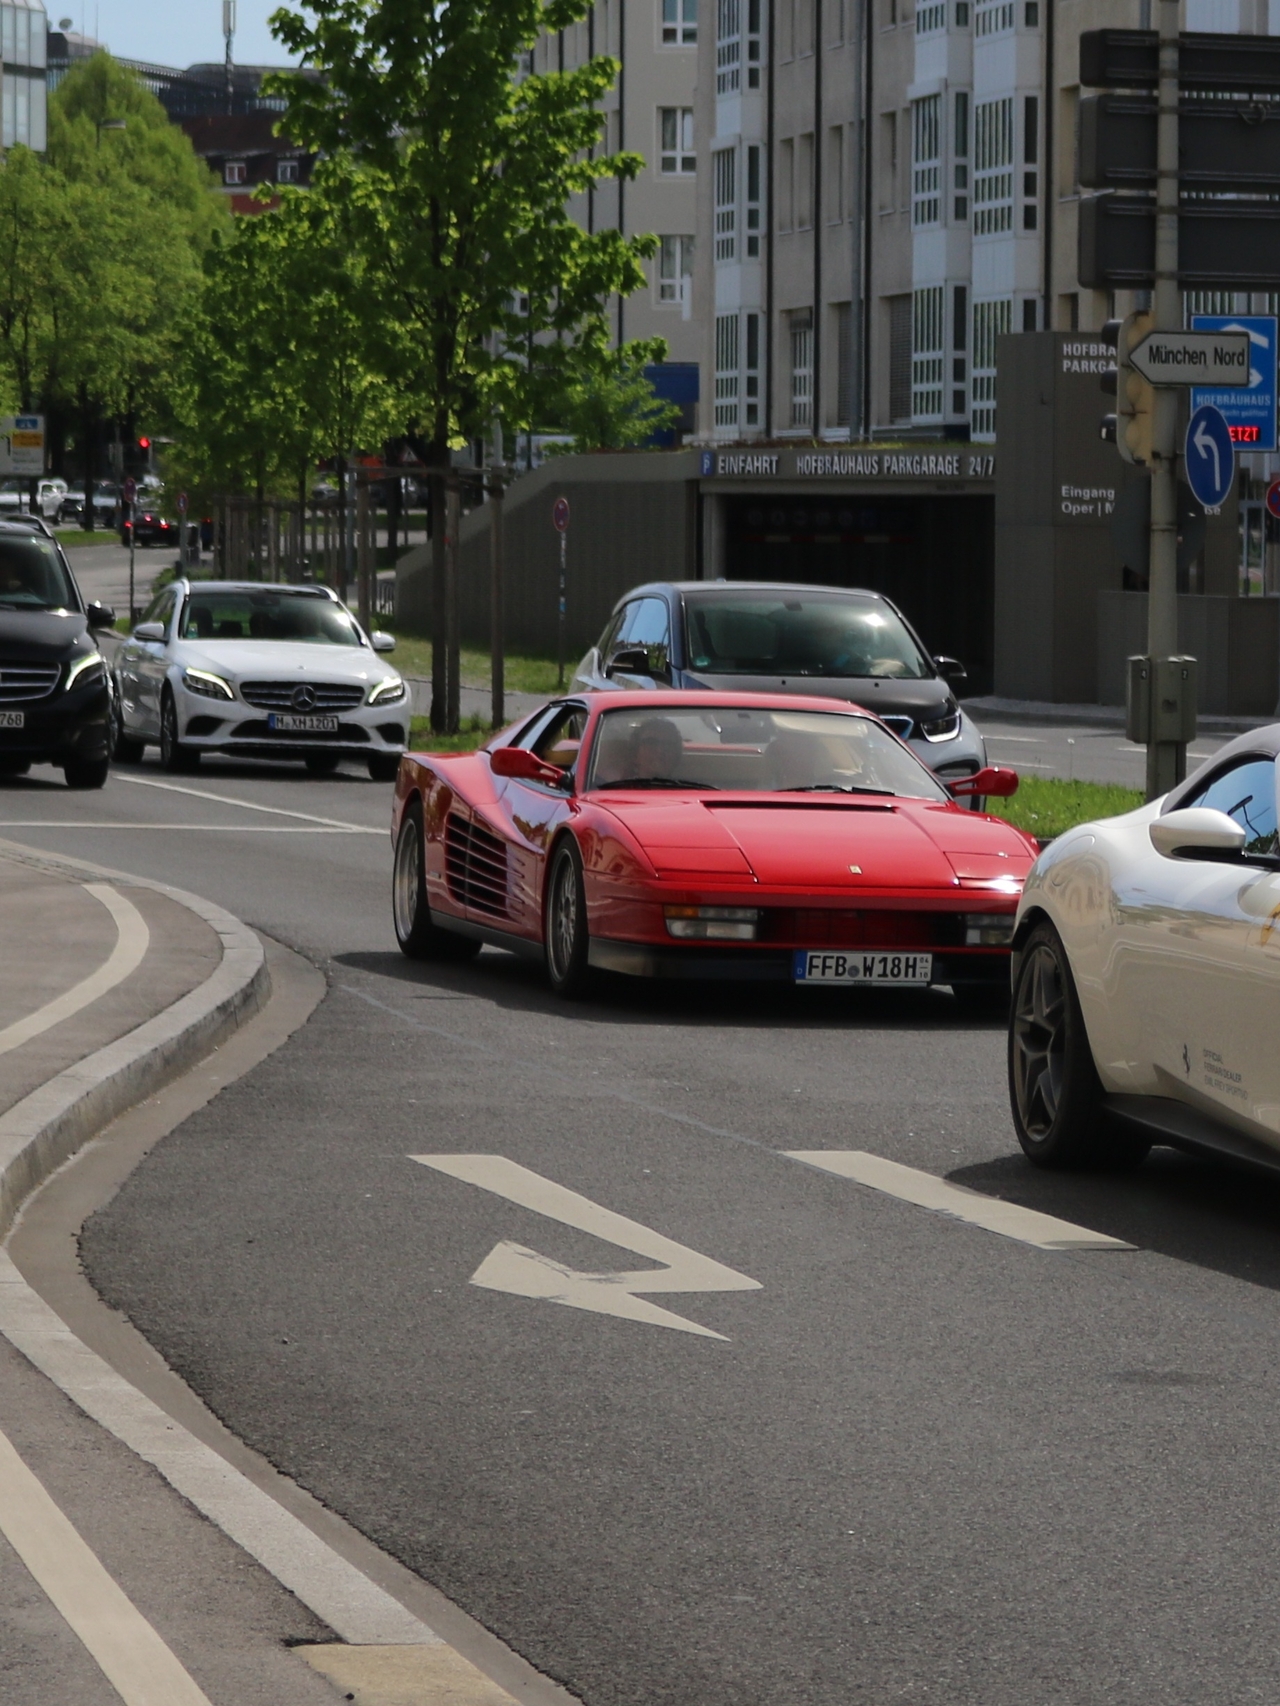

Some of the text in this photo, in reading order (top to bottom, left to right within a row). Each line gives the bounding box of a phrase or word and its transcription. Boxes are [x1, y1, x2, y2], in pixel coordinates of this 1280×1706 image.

[1063, 343, 1117, 357] HOFBRA
[1149, 345, 1245, 366] München Nord
[1063, 359, 1117, 373] PARKGA
[1229, 426, 1259, 442] ETZT
[718, 452, 995, 476] EINFAHRT HOFBRÄUHAUS PARKGARAGE 24/7
[1061, 485, 1115, 501] Eingang
[1061, 502, 1094, 516] Oper
[311, 718, 335, 730] 1201
[808, 955, 847, 977] FFB
